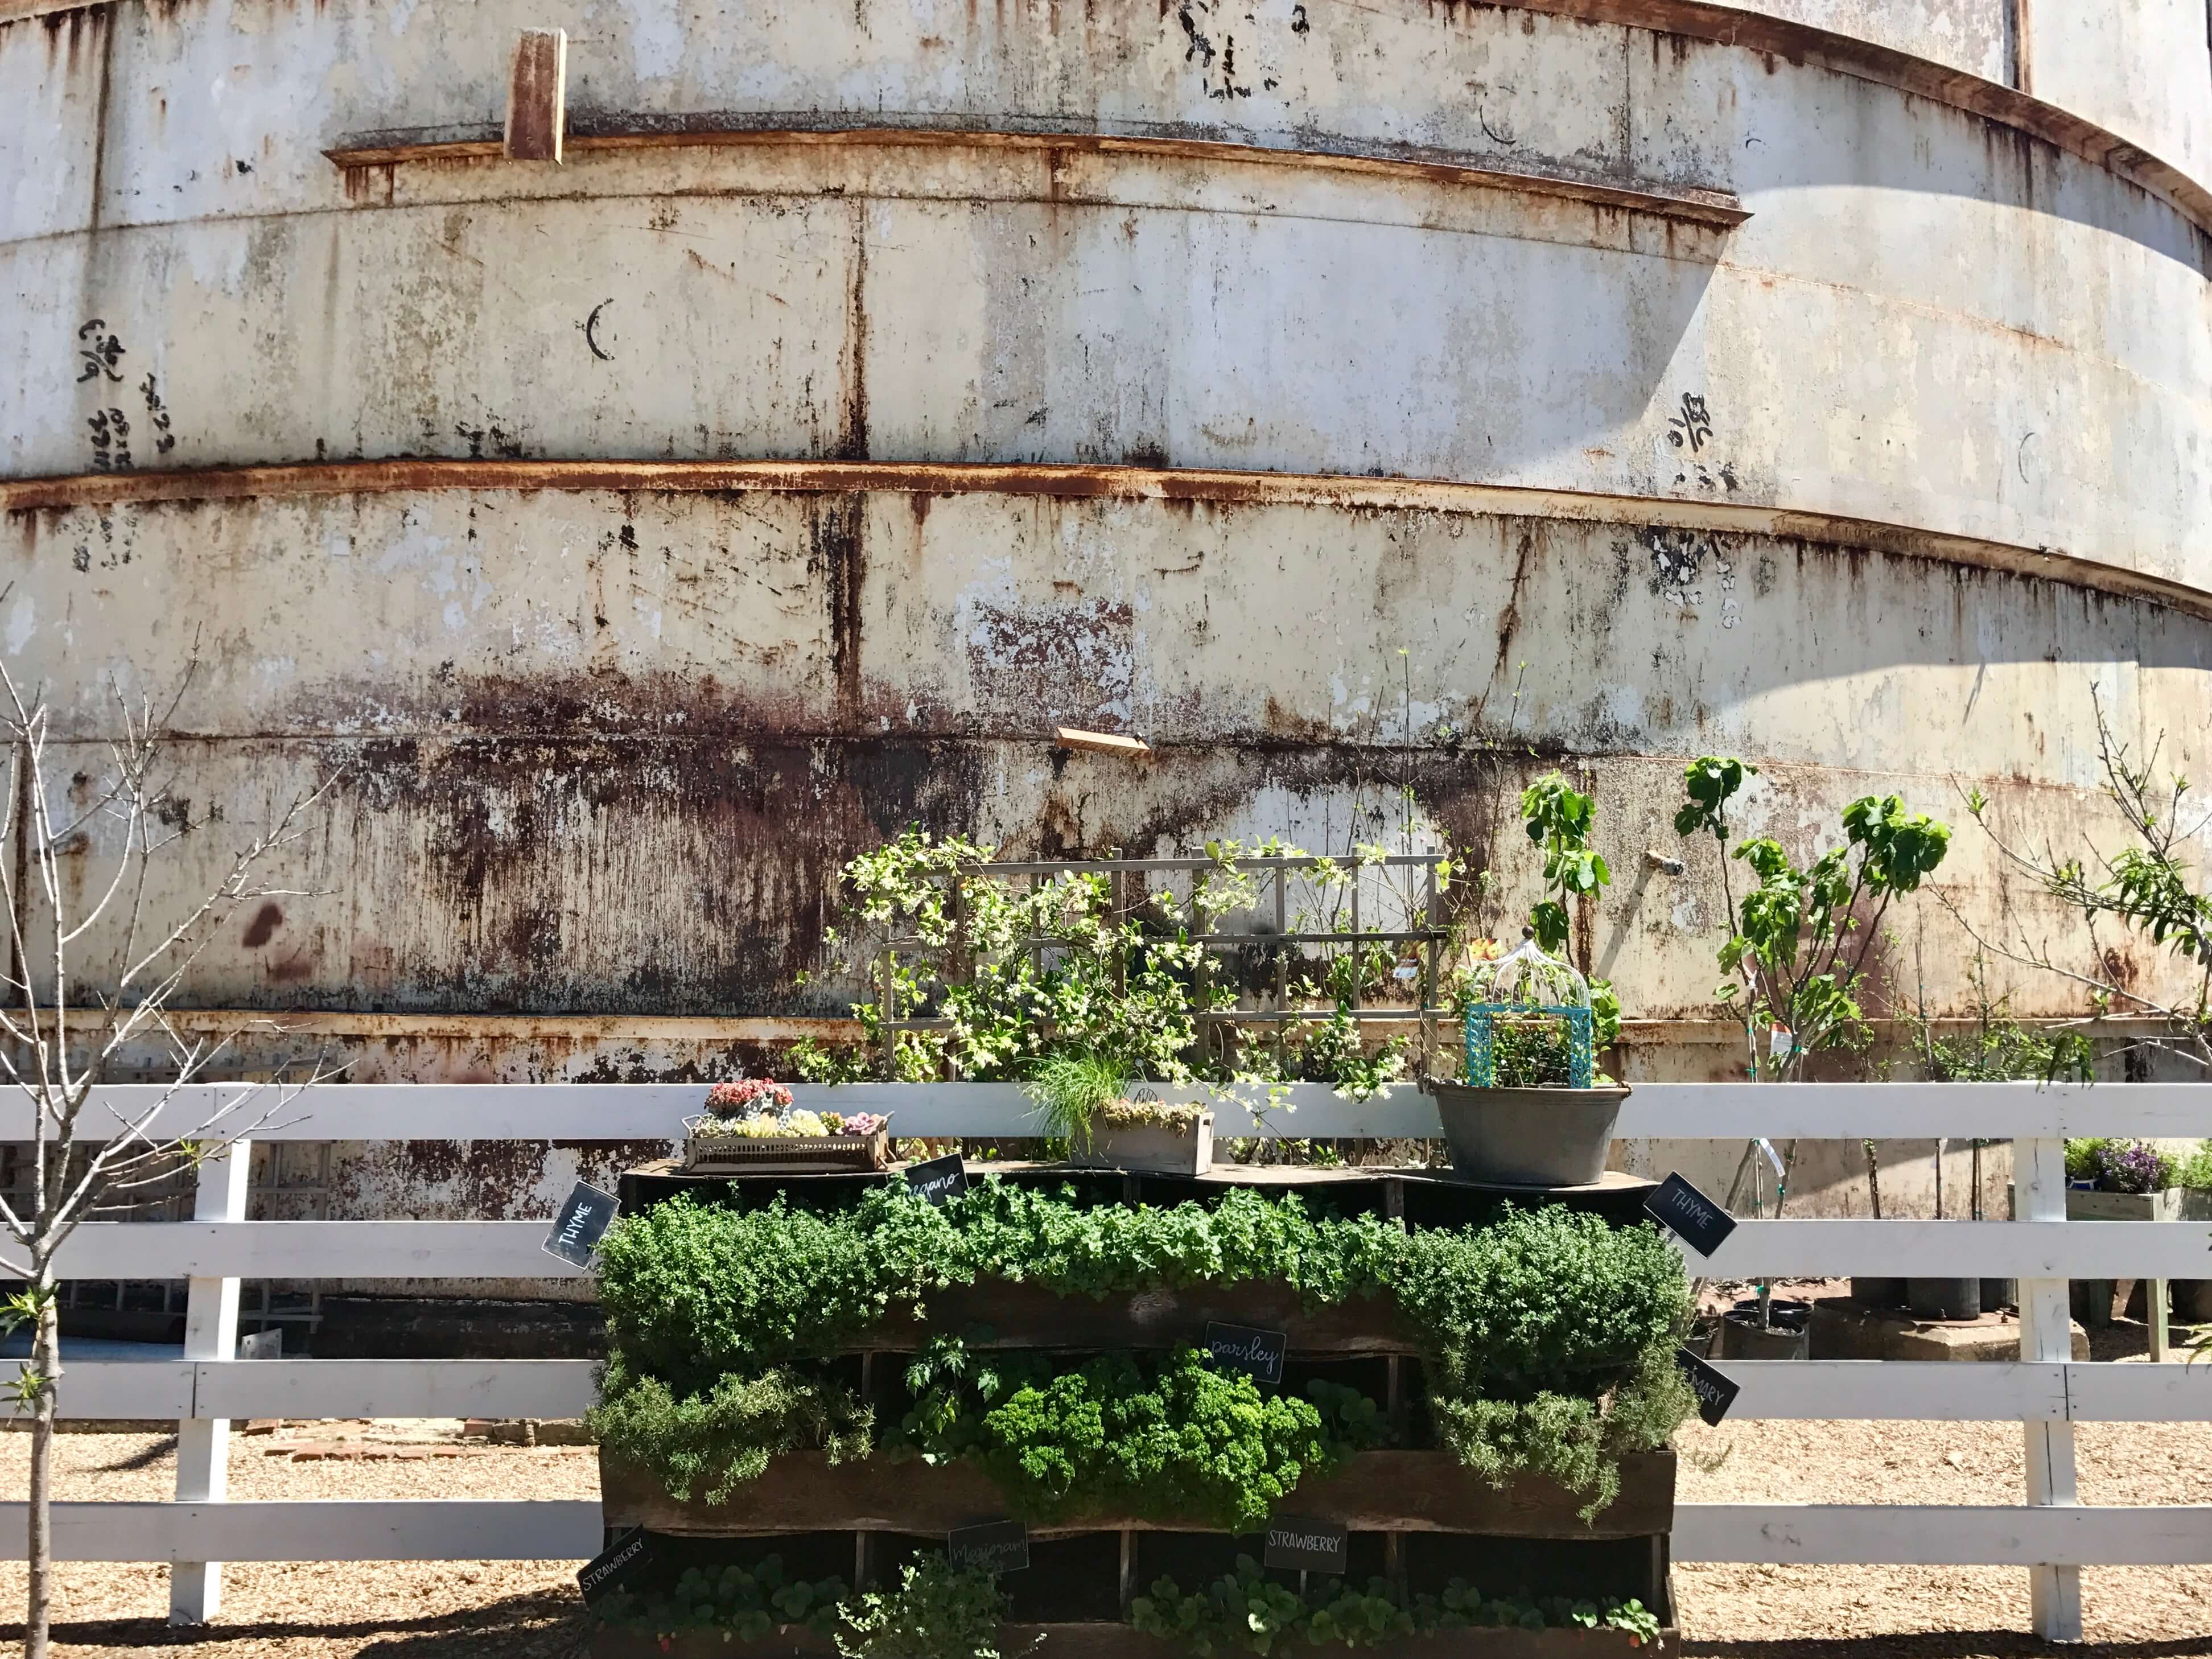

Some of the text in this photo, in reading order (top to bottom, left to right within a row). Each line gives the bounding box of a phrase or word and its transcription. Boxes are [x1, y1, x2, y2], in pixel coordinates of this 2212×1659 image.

[908, 1172, 959, 1202] egano
[558, 1202, 592, 1245] THYME
[1671, 1188, 1713, 1230] THYME
[1211, 1335, 1279, 1375] parsley
[1676, 1362, 1725, 1406] MARY
[1268, 1529, 1341, 1553] STRAWBERRY
[582, 1537, 644, 1592] STRAWBERRY
